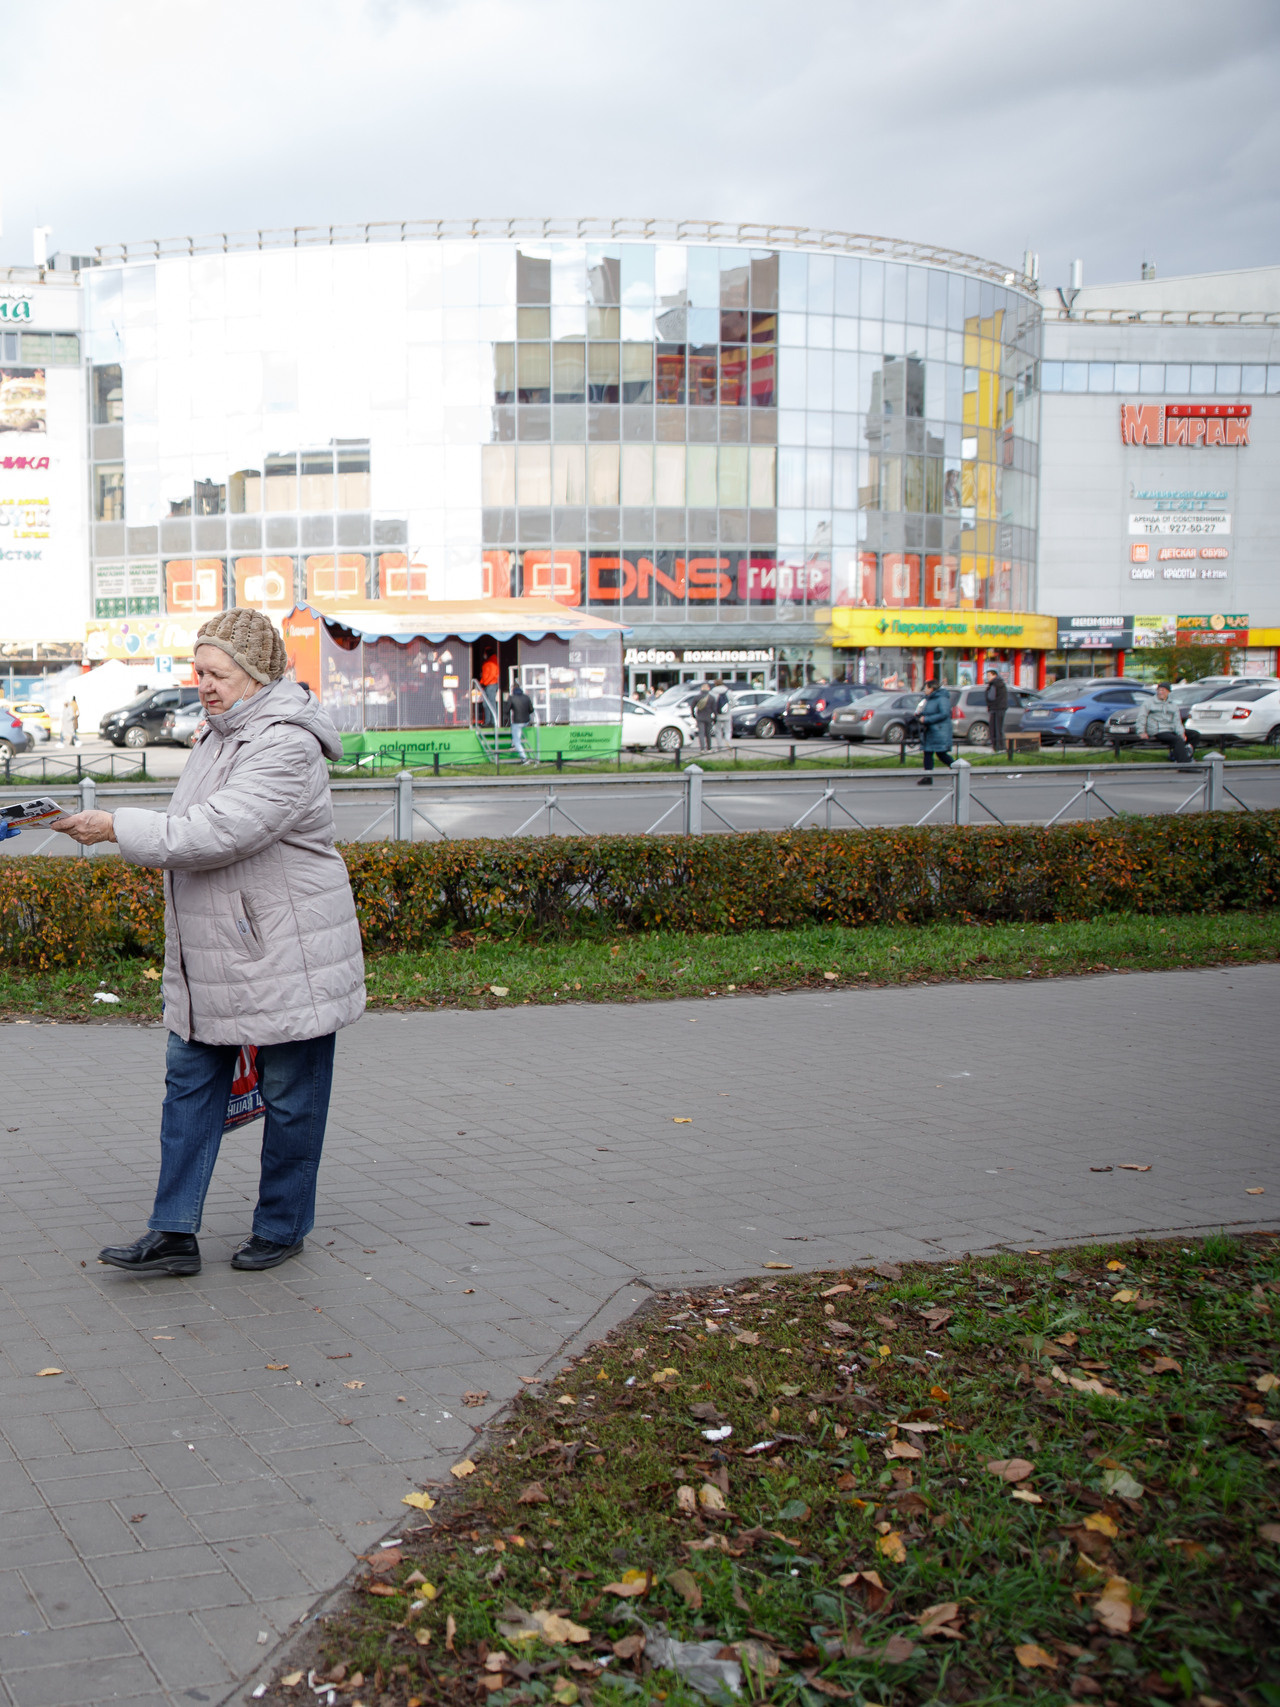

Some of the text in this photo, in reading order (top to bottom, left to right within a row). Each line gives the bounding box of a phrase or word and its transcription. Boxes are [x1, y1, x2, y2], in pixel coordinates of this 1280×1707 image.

[1172, 406, 1248, 415] CINEMA
[1133, 516, 1161, 524] АРЕНДА
[588, 557, 733, 600] DNS
[747, 567, 824, 590] ГИПЕР
[1071, 616, 1124, 627] REDMOND
[624, 647, 775, 665] Добро пожаловать!
[379, 740, 451, 752] galamart.ru
